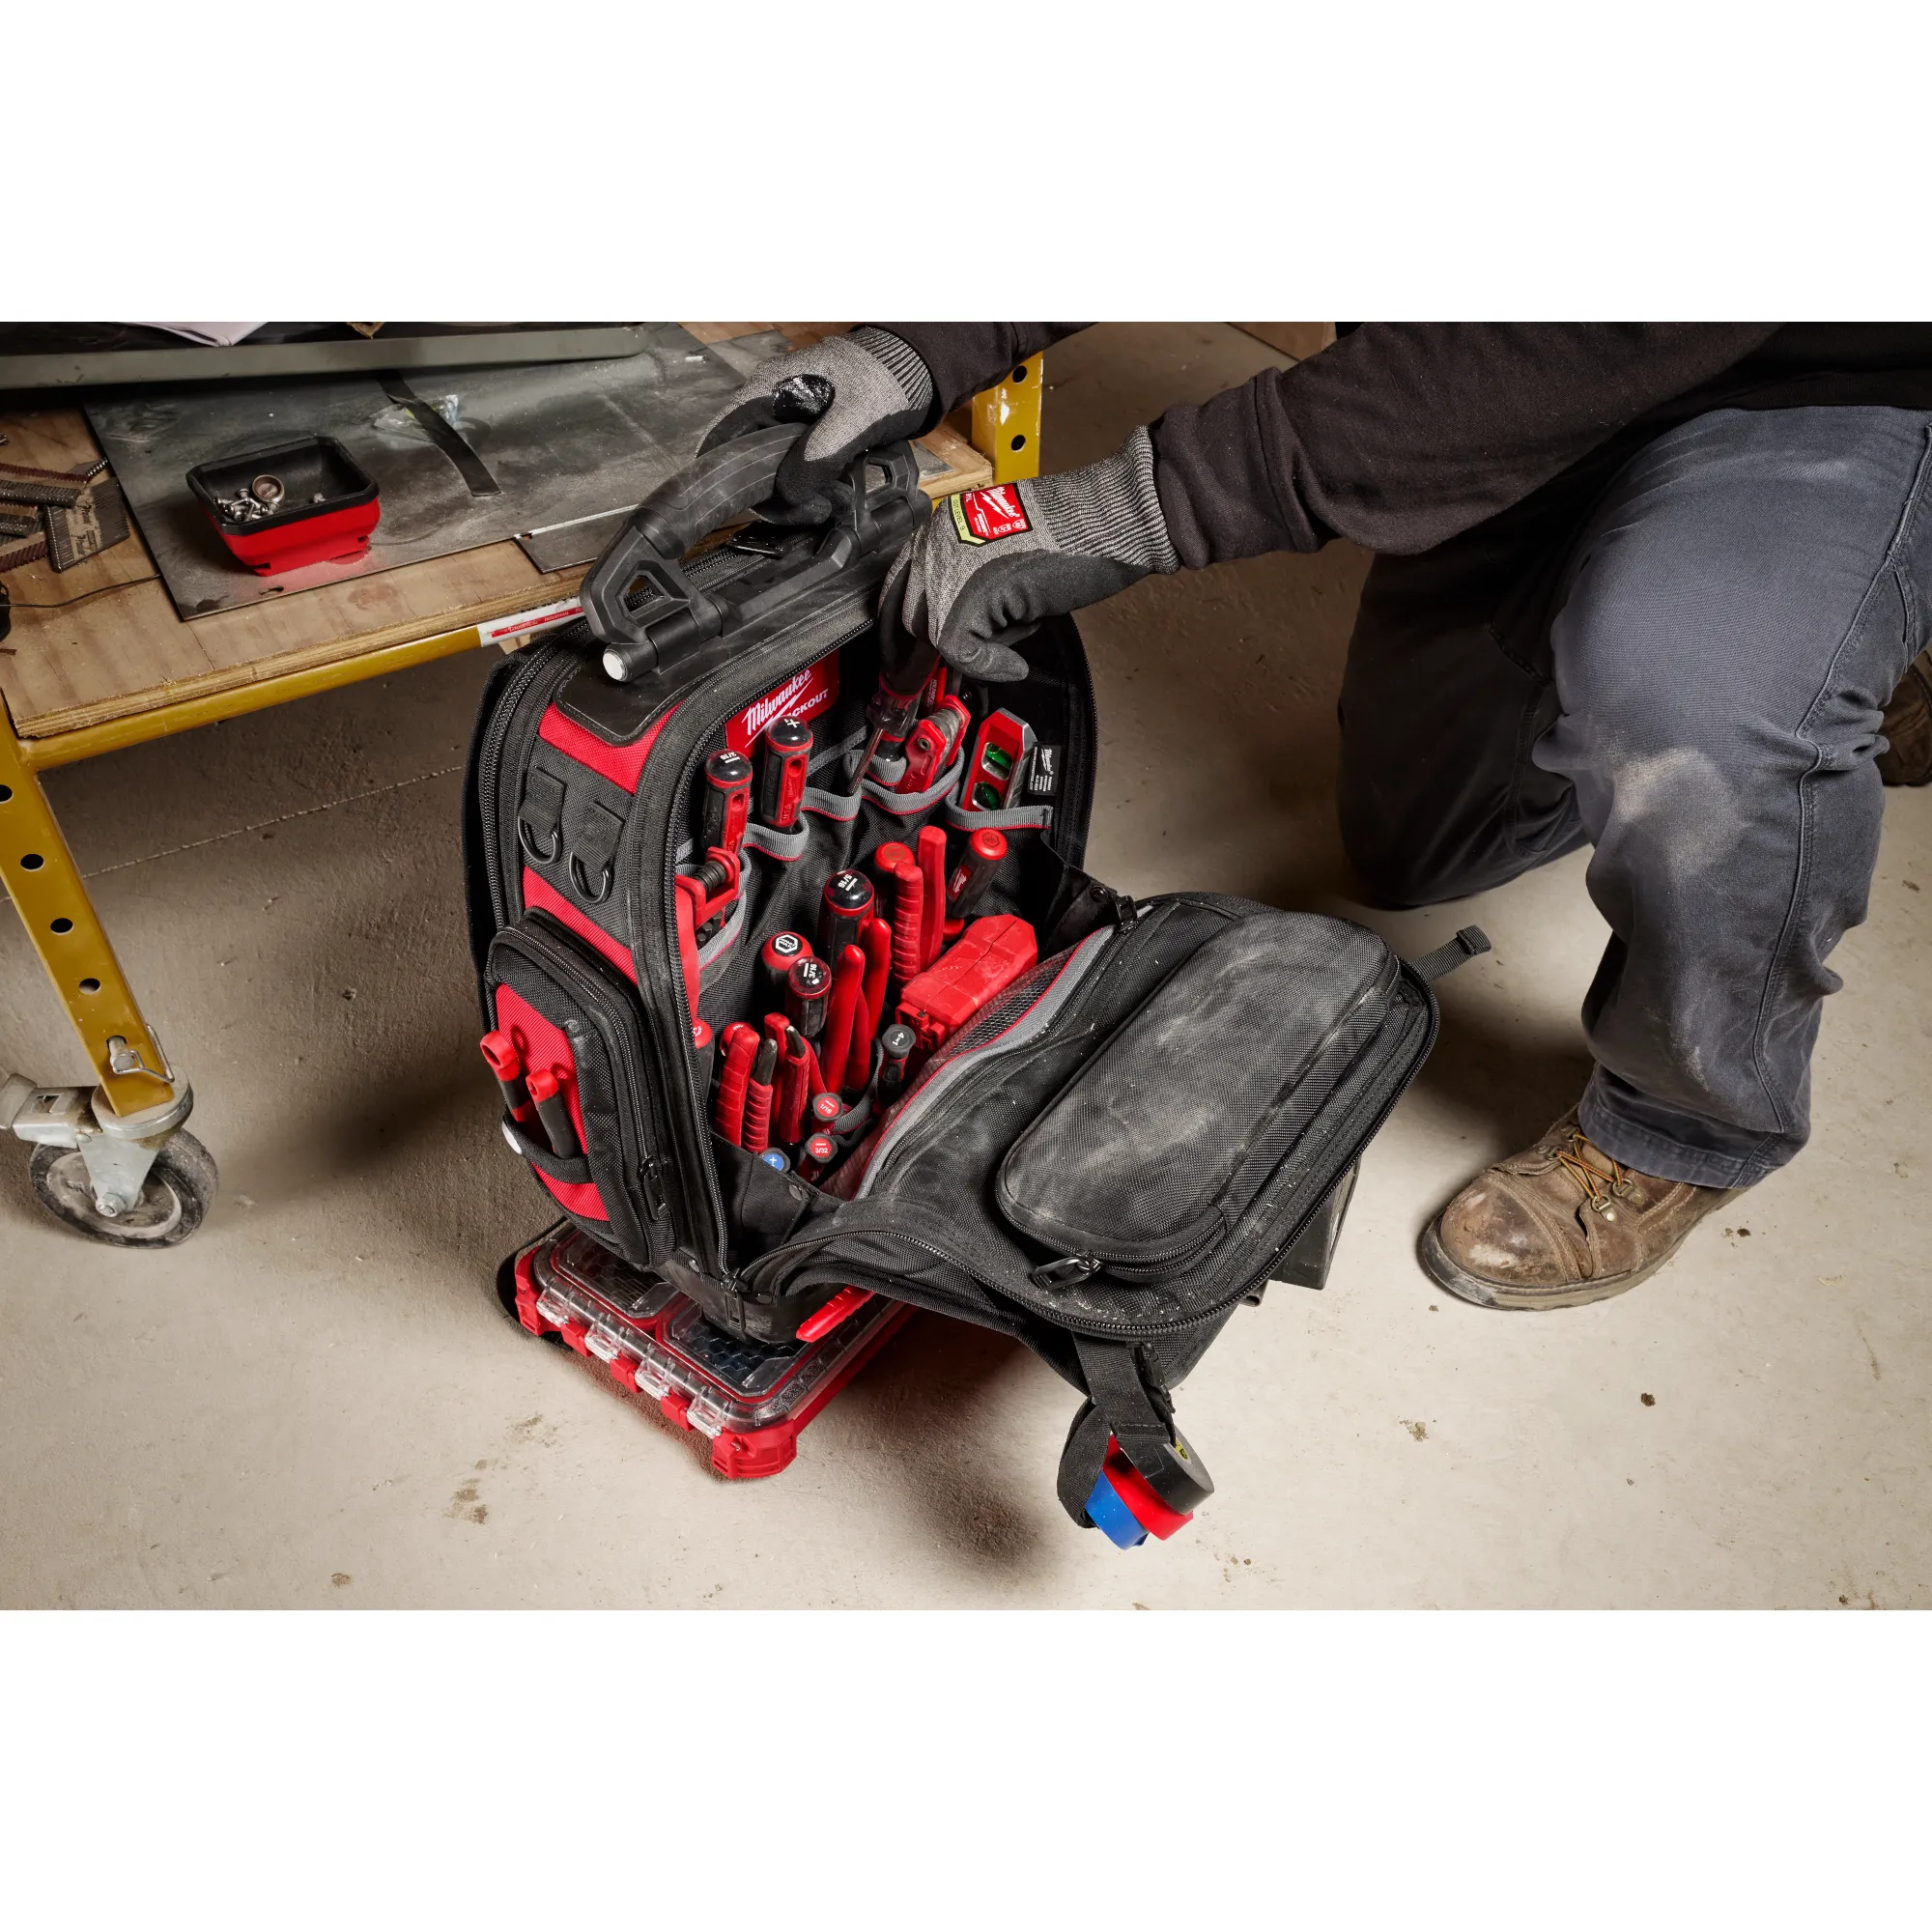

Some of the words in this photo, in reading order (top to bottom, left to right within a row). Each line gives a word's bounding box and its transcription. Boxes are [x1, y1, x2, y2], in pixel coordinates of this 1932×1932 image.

[986, 486, 1017, 518] Milwaukee
[742, 669, 811, 735] Milwaukee
[838, 874, 853, 889] 5/16
[809, 963, 817, 979] 3/16
[820, 1103, 833, 1115] 1/16
